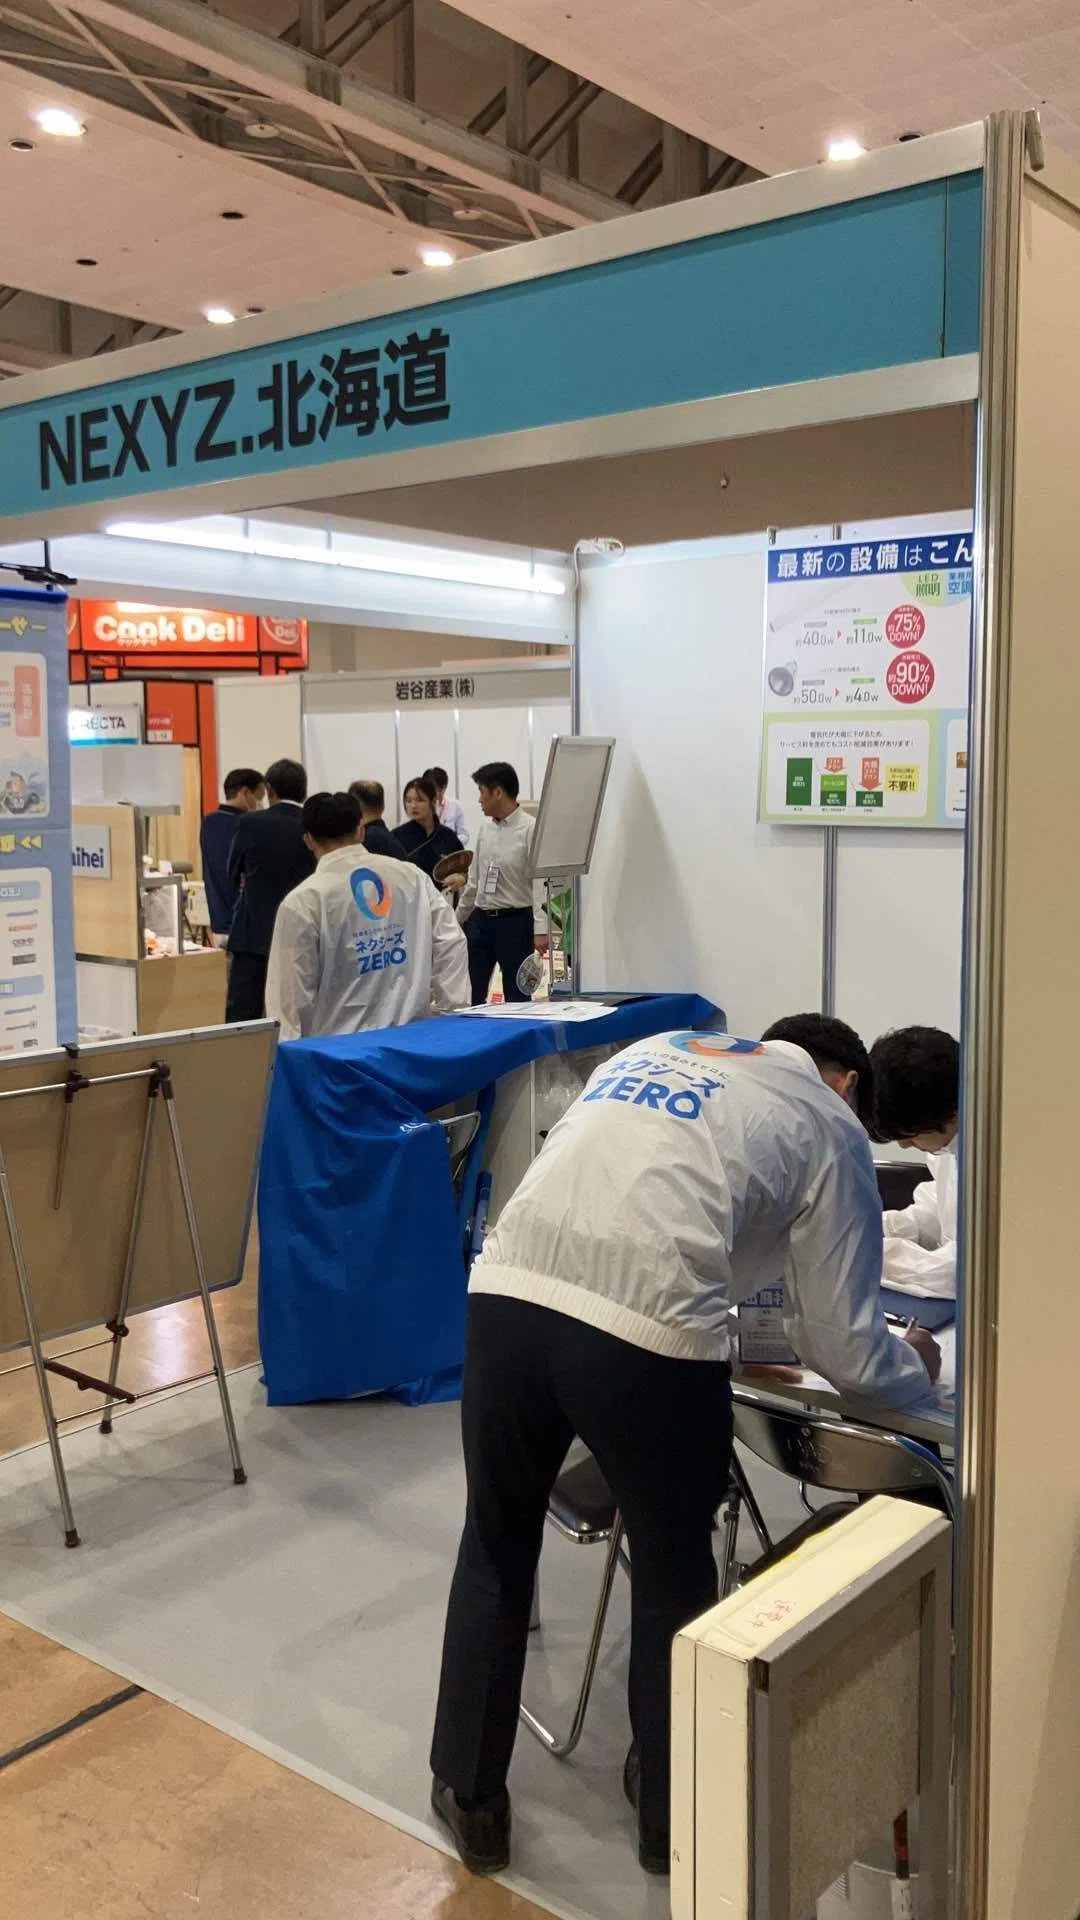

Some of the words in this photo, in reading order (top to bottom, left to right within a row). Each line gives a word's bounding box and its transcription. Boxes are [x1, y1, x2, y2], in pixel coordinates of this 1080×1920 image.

[95, 615, 178, 642] Cook
[183, 615, 246, 642] Deli
[889, 631, 920, 642] DOWN!
[891, 683, 928, 696] DOWN!
[358, 947, 407, 975] ZERO
[607, 1059, 725, 1098] ネクシーズ
[583, 1076, 702, 1120] ZERO
